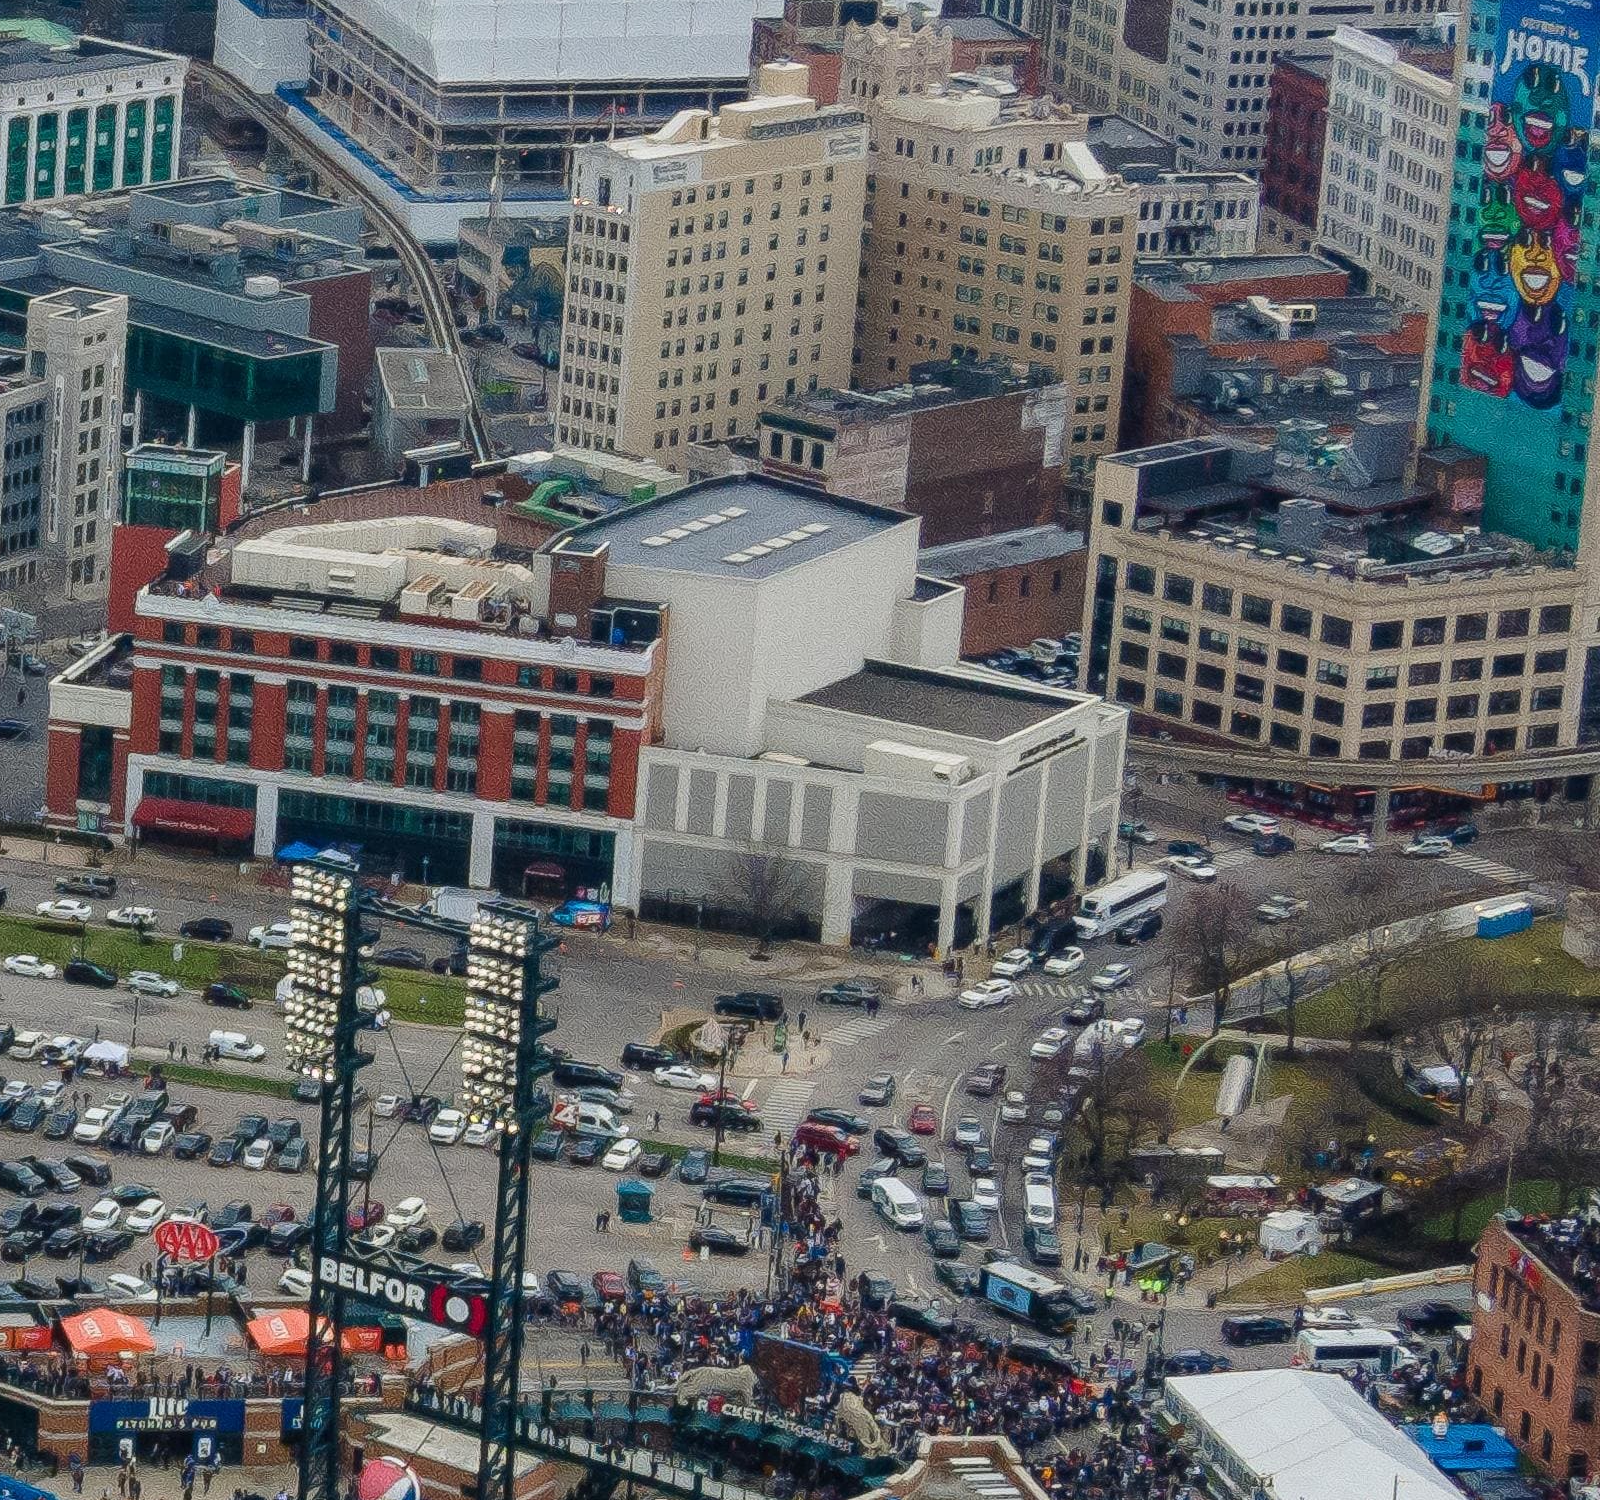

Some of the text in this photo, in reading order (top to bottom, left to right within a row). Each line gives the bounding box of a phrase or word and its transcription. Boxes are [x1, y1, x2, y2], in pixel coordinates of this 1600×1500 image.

[1501, 29, 1590, 96] HOME
[159, 1224, 219, 1259] AAA
[319, 1257, 426, 1311] BELFOR
